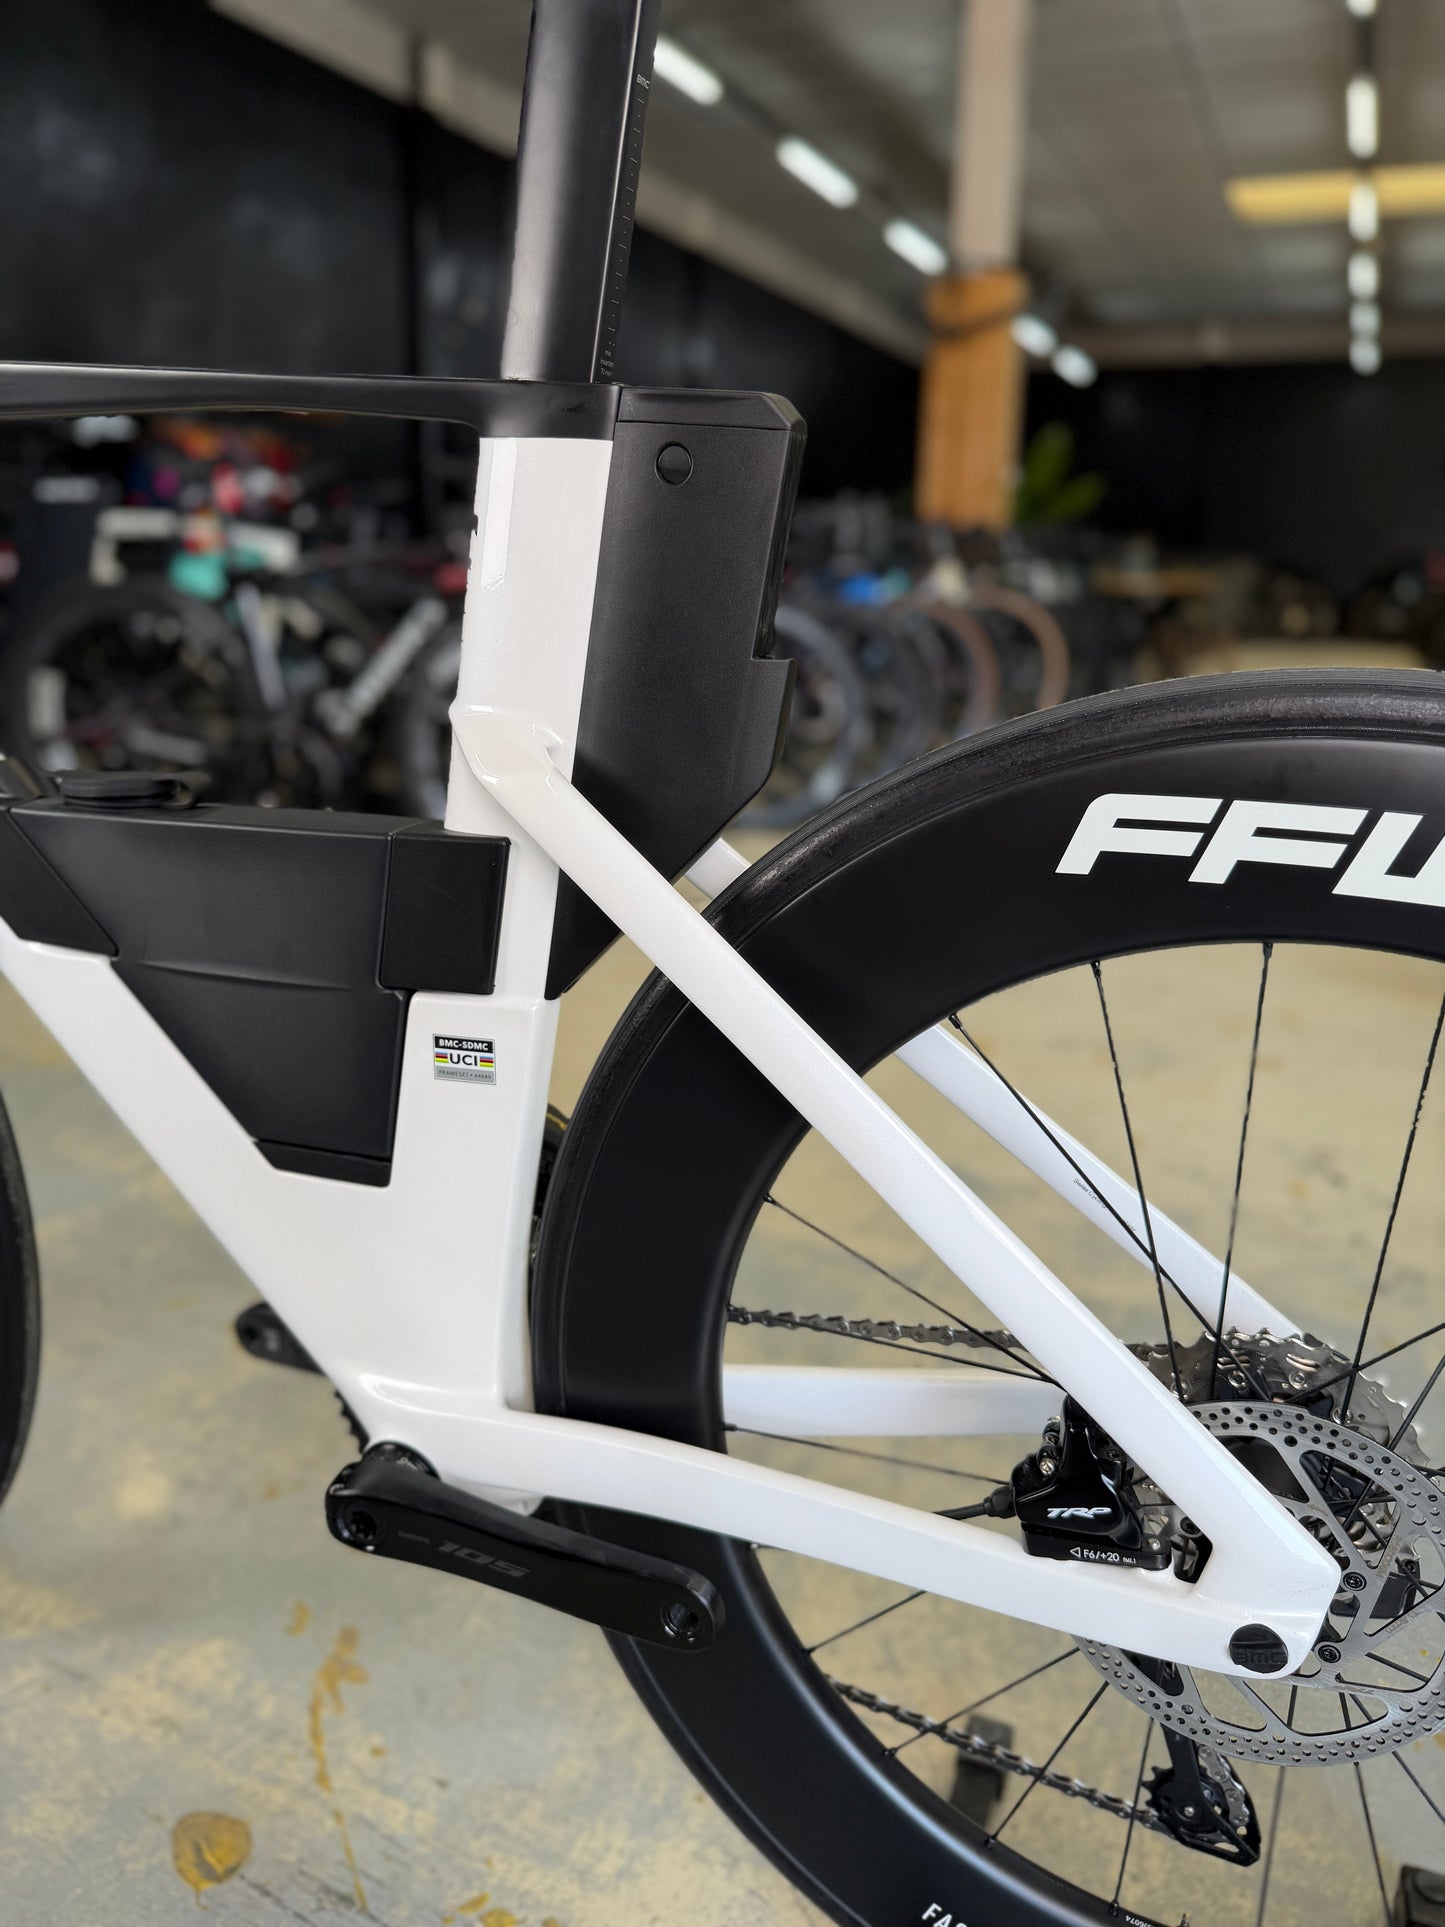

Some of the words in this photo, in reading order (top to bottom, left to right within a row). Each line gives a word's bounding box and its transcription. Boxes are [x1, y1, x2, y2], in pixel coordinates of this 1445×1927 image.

[438, 1039, 489, 1051] BMC-SDMC
[449, 1053, 478, 1067] UCI
[1046, 1506, 1113, 1520] TRP
[438, 1540, 531, 1577] 105
[1083, 1548, 1120, 1562] F6/+20
